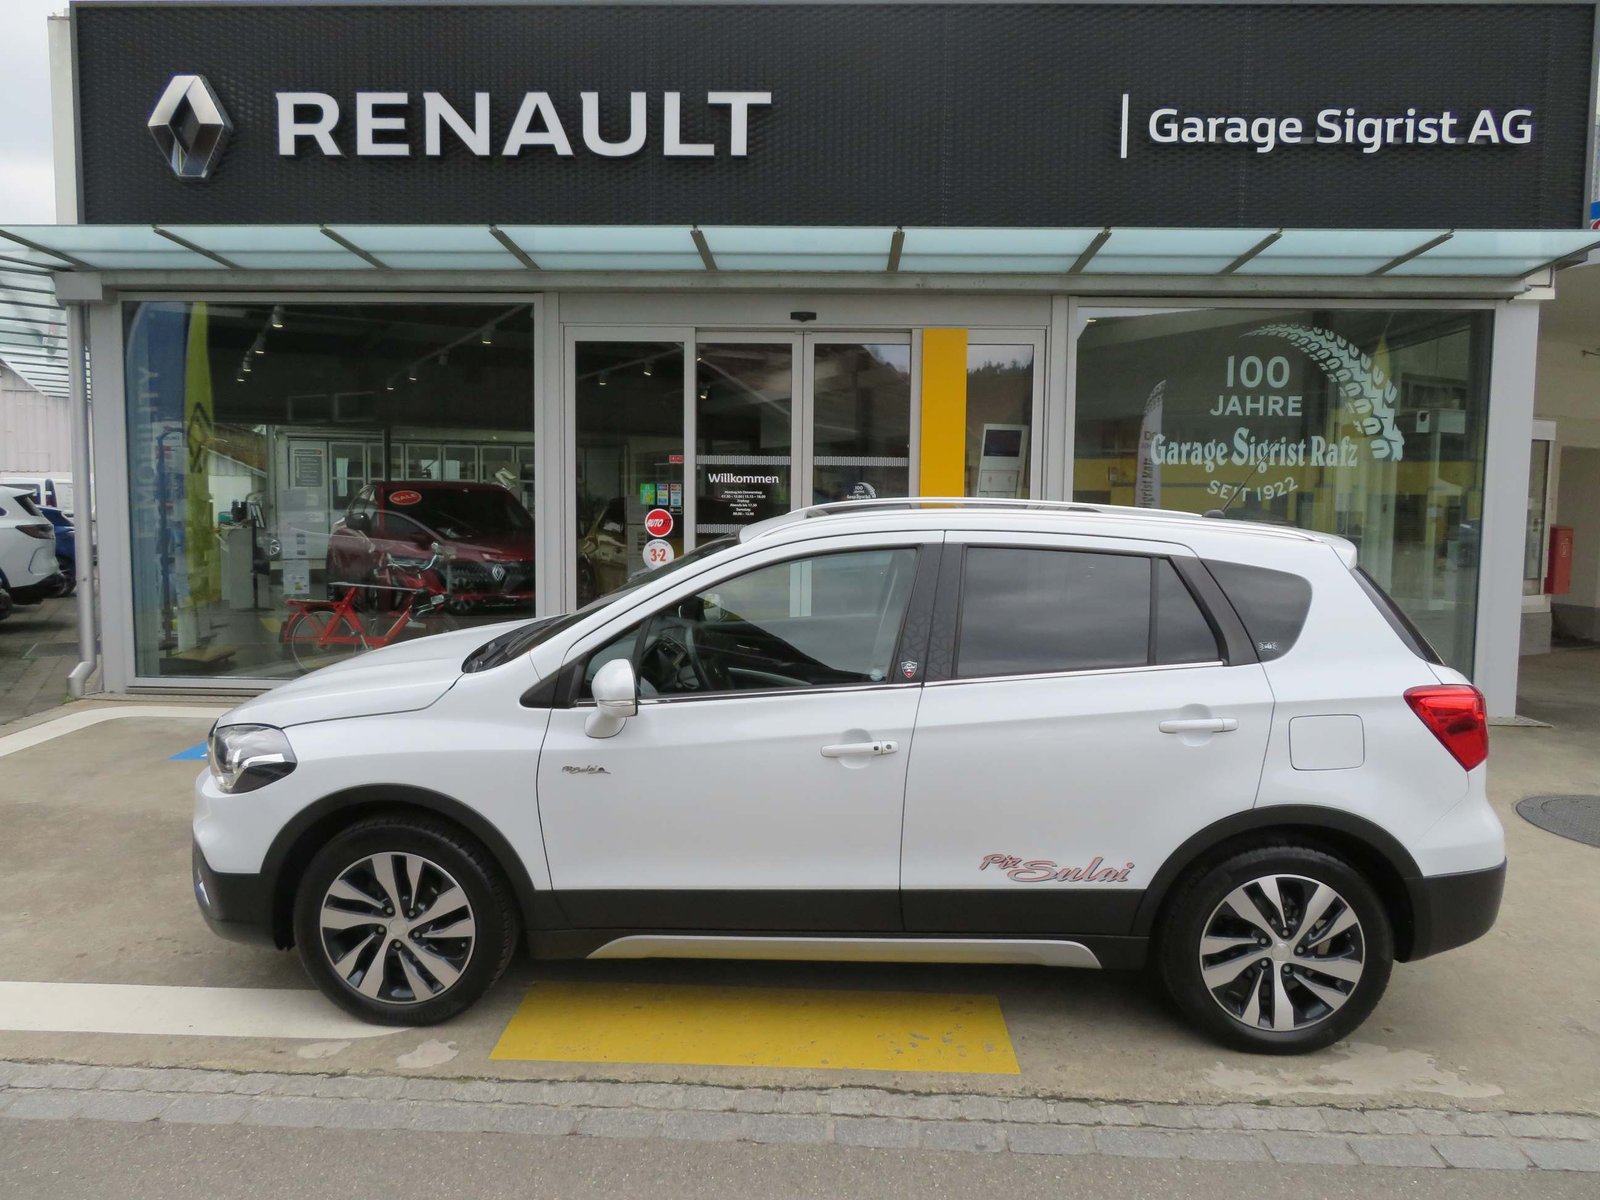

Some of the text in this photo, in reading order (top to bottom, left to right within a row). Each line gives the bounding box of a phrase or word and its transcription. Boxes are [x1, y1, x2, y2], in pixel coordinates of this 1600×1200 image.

[275, 92, 772, 156] RENAULT
[1148, 107, 1532, 154] Garage Sigrist AG
[1226, 355, 1290, 388] 100
[1209, 395, 1303, 417] JAHRE
[1150, 433, 1228, 473] Garage
[1230, 427, 1306, 474] Sigrist
[1310, 435, 1358, 467] Rafz
[708, 473, 780, 484] Willkommen
[1207, 476, 1299, 502] SEIT 1922
[978, 853, 1135, 883] Piz Sulai
